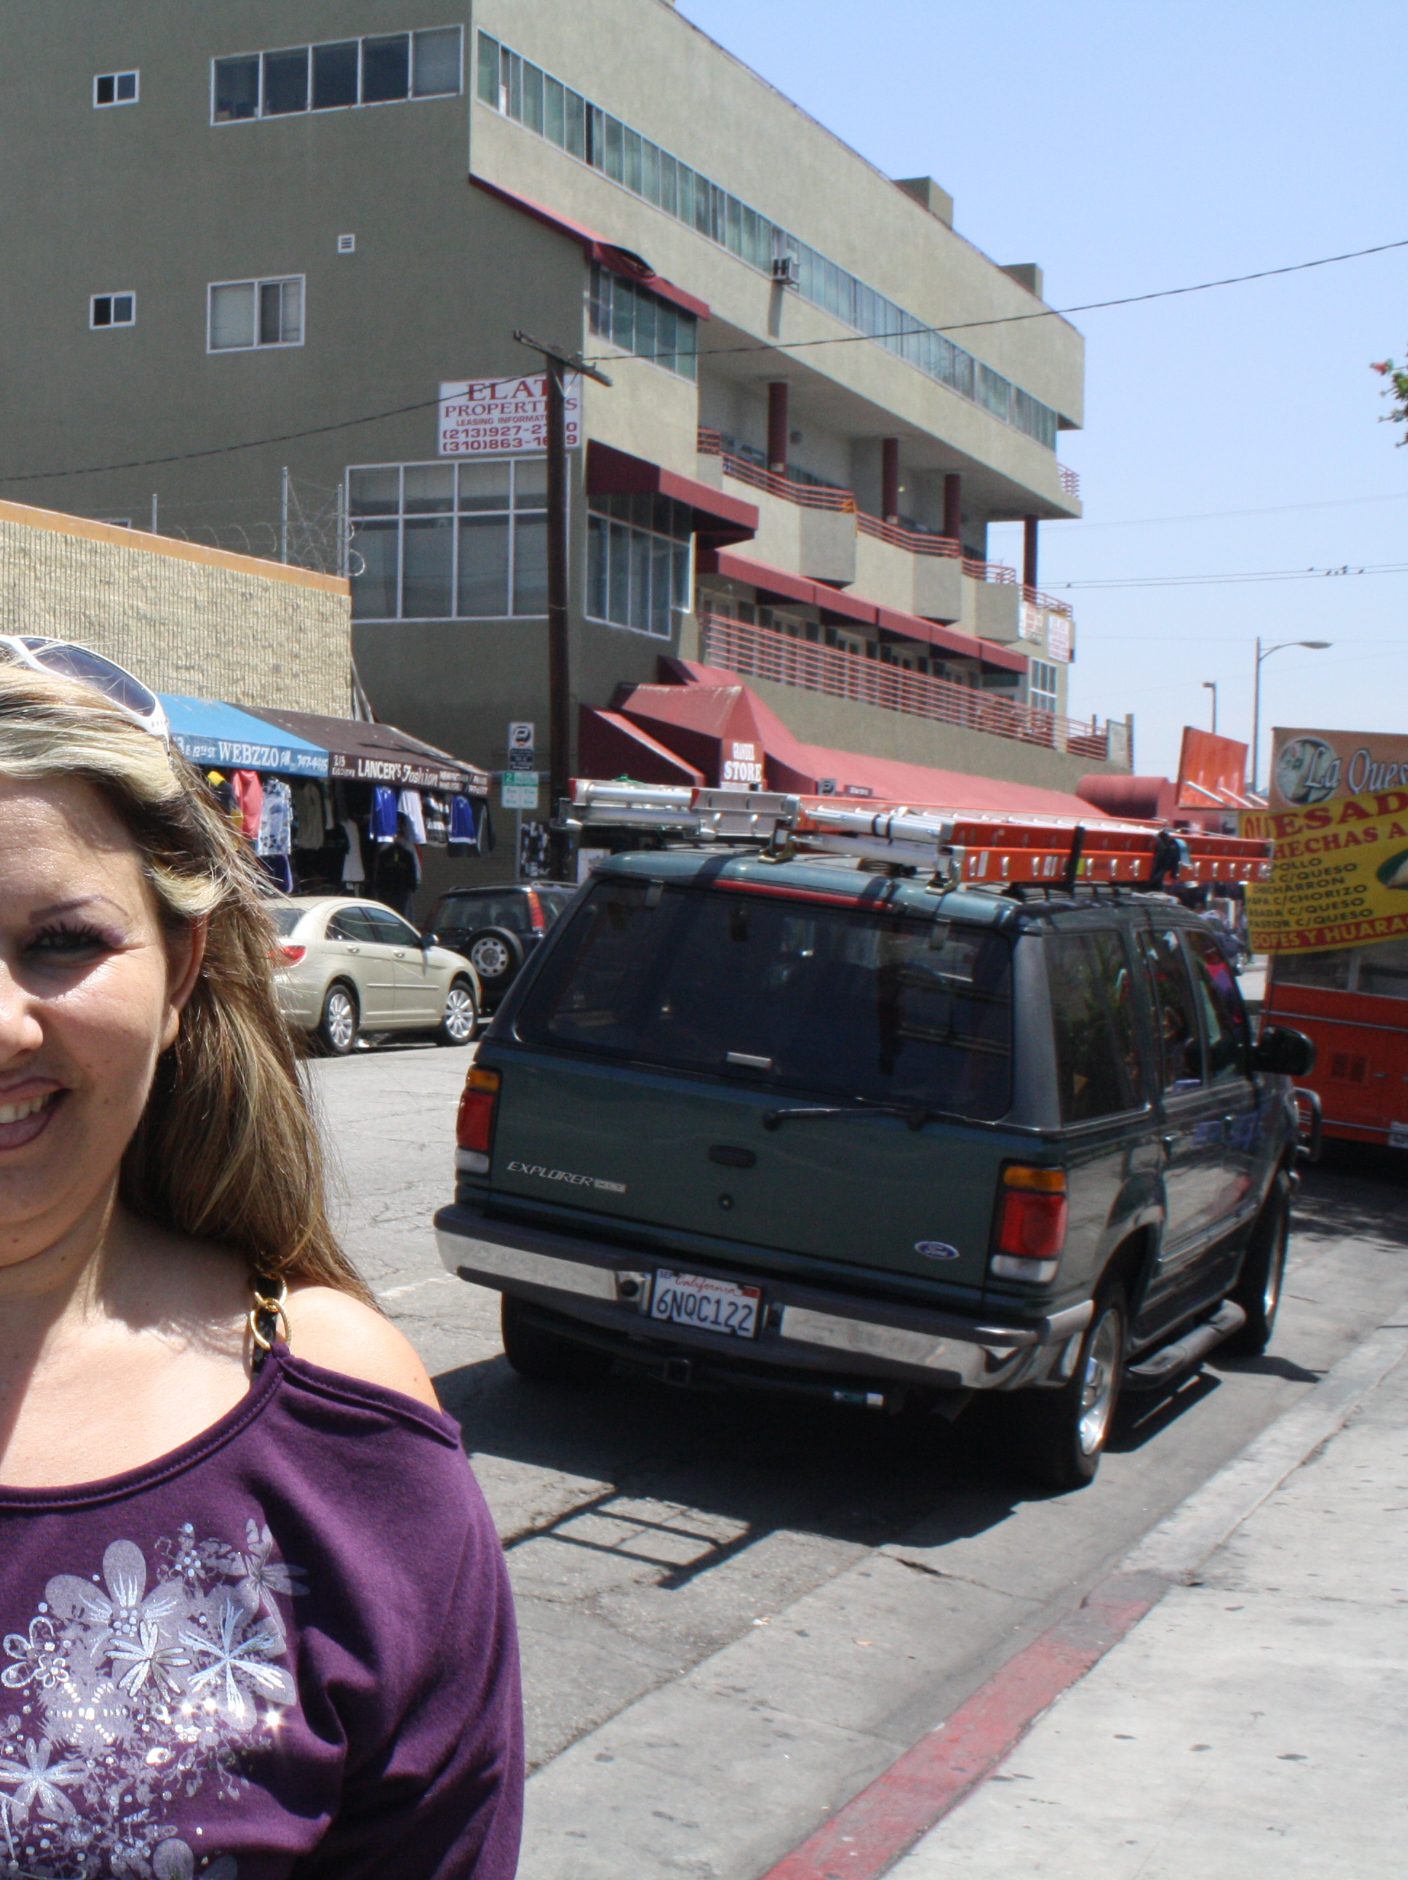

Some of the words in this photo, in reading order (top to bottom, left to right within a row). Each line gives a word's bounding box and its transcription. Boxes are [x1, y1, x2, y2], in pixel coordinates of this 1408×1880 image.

[456, 417, 494, 427] LEASING
[218, 740, 279, 767] WEBZZO
[357, 758, 402, 782] LANCER'S
[401, 763, 439, 788] Fashion
[723, 760, 762, 782] STORE
[1304, 747, 1341, 788] La
[1273, 826, 1379, 861] HECHAS
[1287, 897, 1364, 916] C/QUESO
[1295, 908, 1373, 927] C/QUESO
[1305, 932, 1317, 944] Y
[506, 1160, 594, 1187] EXPLORER
